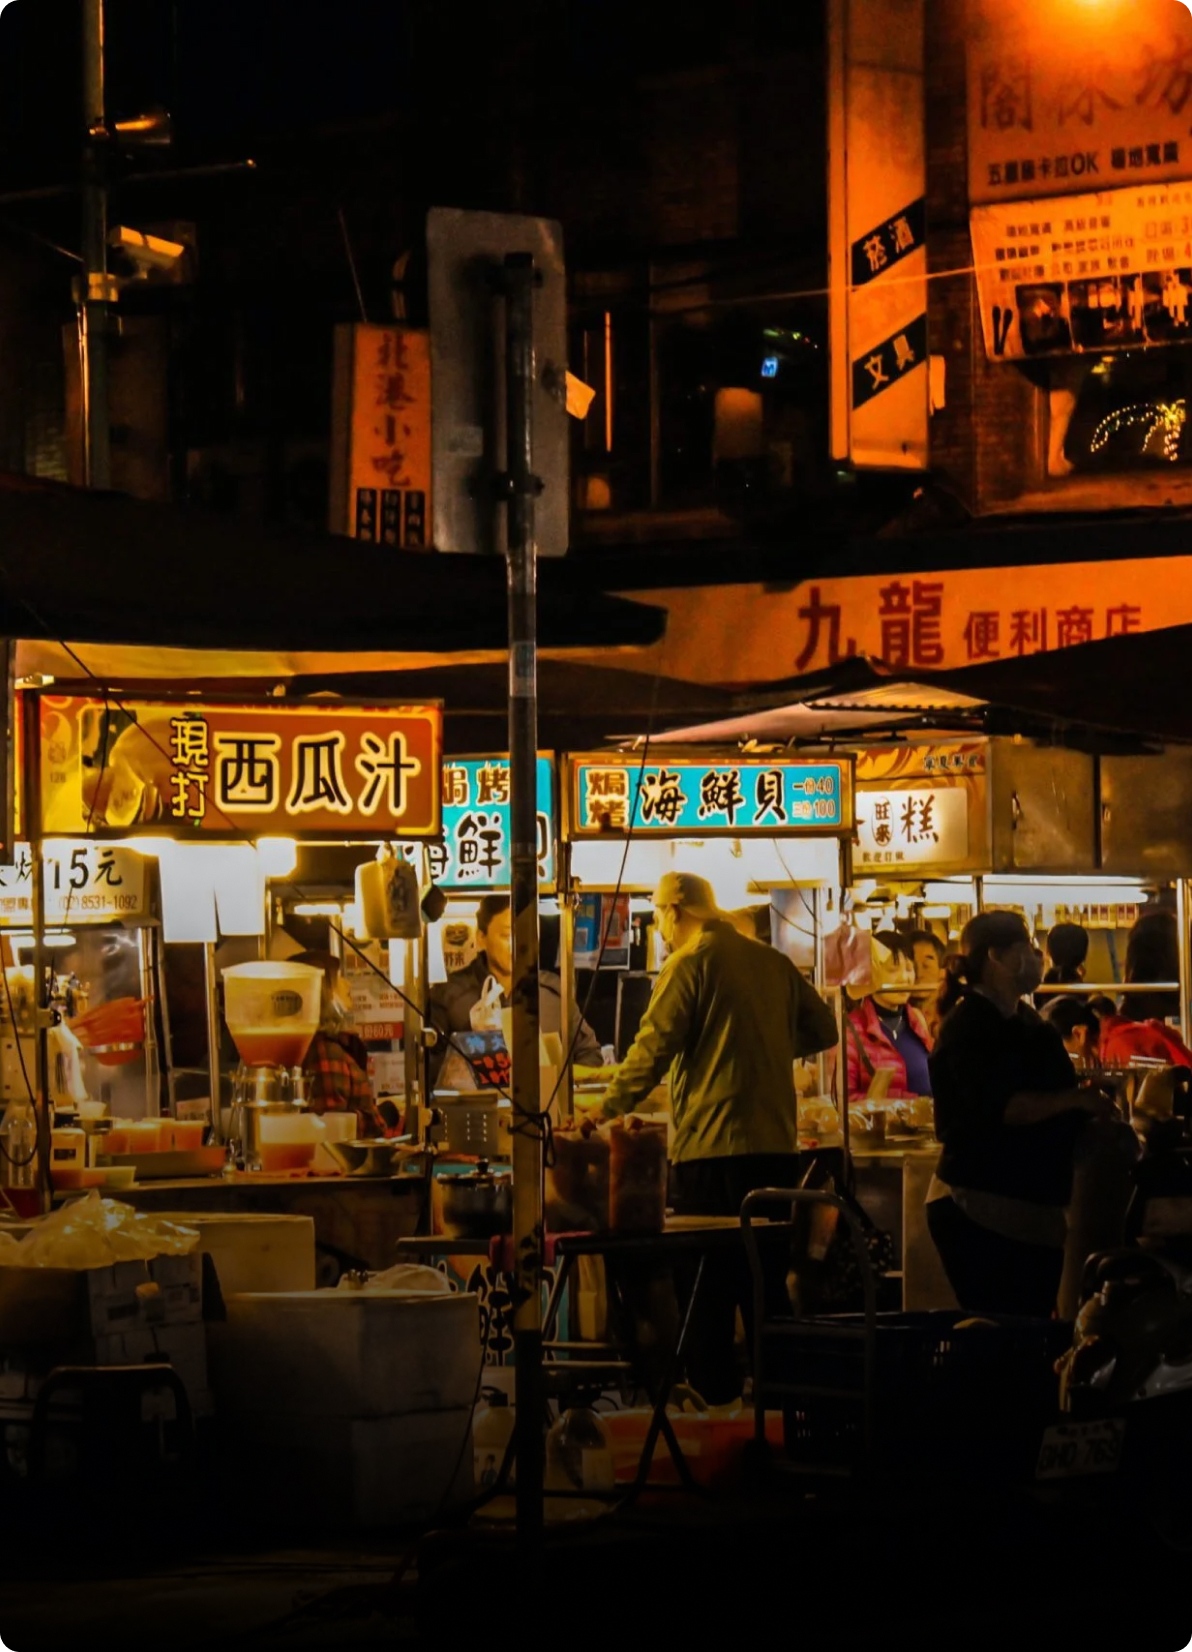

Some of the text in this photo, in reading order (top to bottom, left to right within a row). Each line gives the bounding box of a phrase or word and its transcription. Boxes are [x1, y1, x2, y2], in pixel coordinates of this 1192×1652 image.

[864, 334, 914, 390] 文具
[795, 580, 1142, 670] 九龍 便利商店
[170, 718, 208, 817] 現打
[215, 732, 419, 814] 西瓜汁
[793, 776, 835, 795] 一份40
[641, 768, 787, 827] 海鮮貝
[900, 793, 939, 843] 糕
[53, 848, 123, 889] 15元
